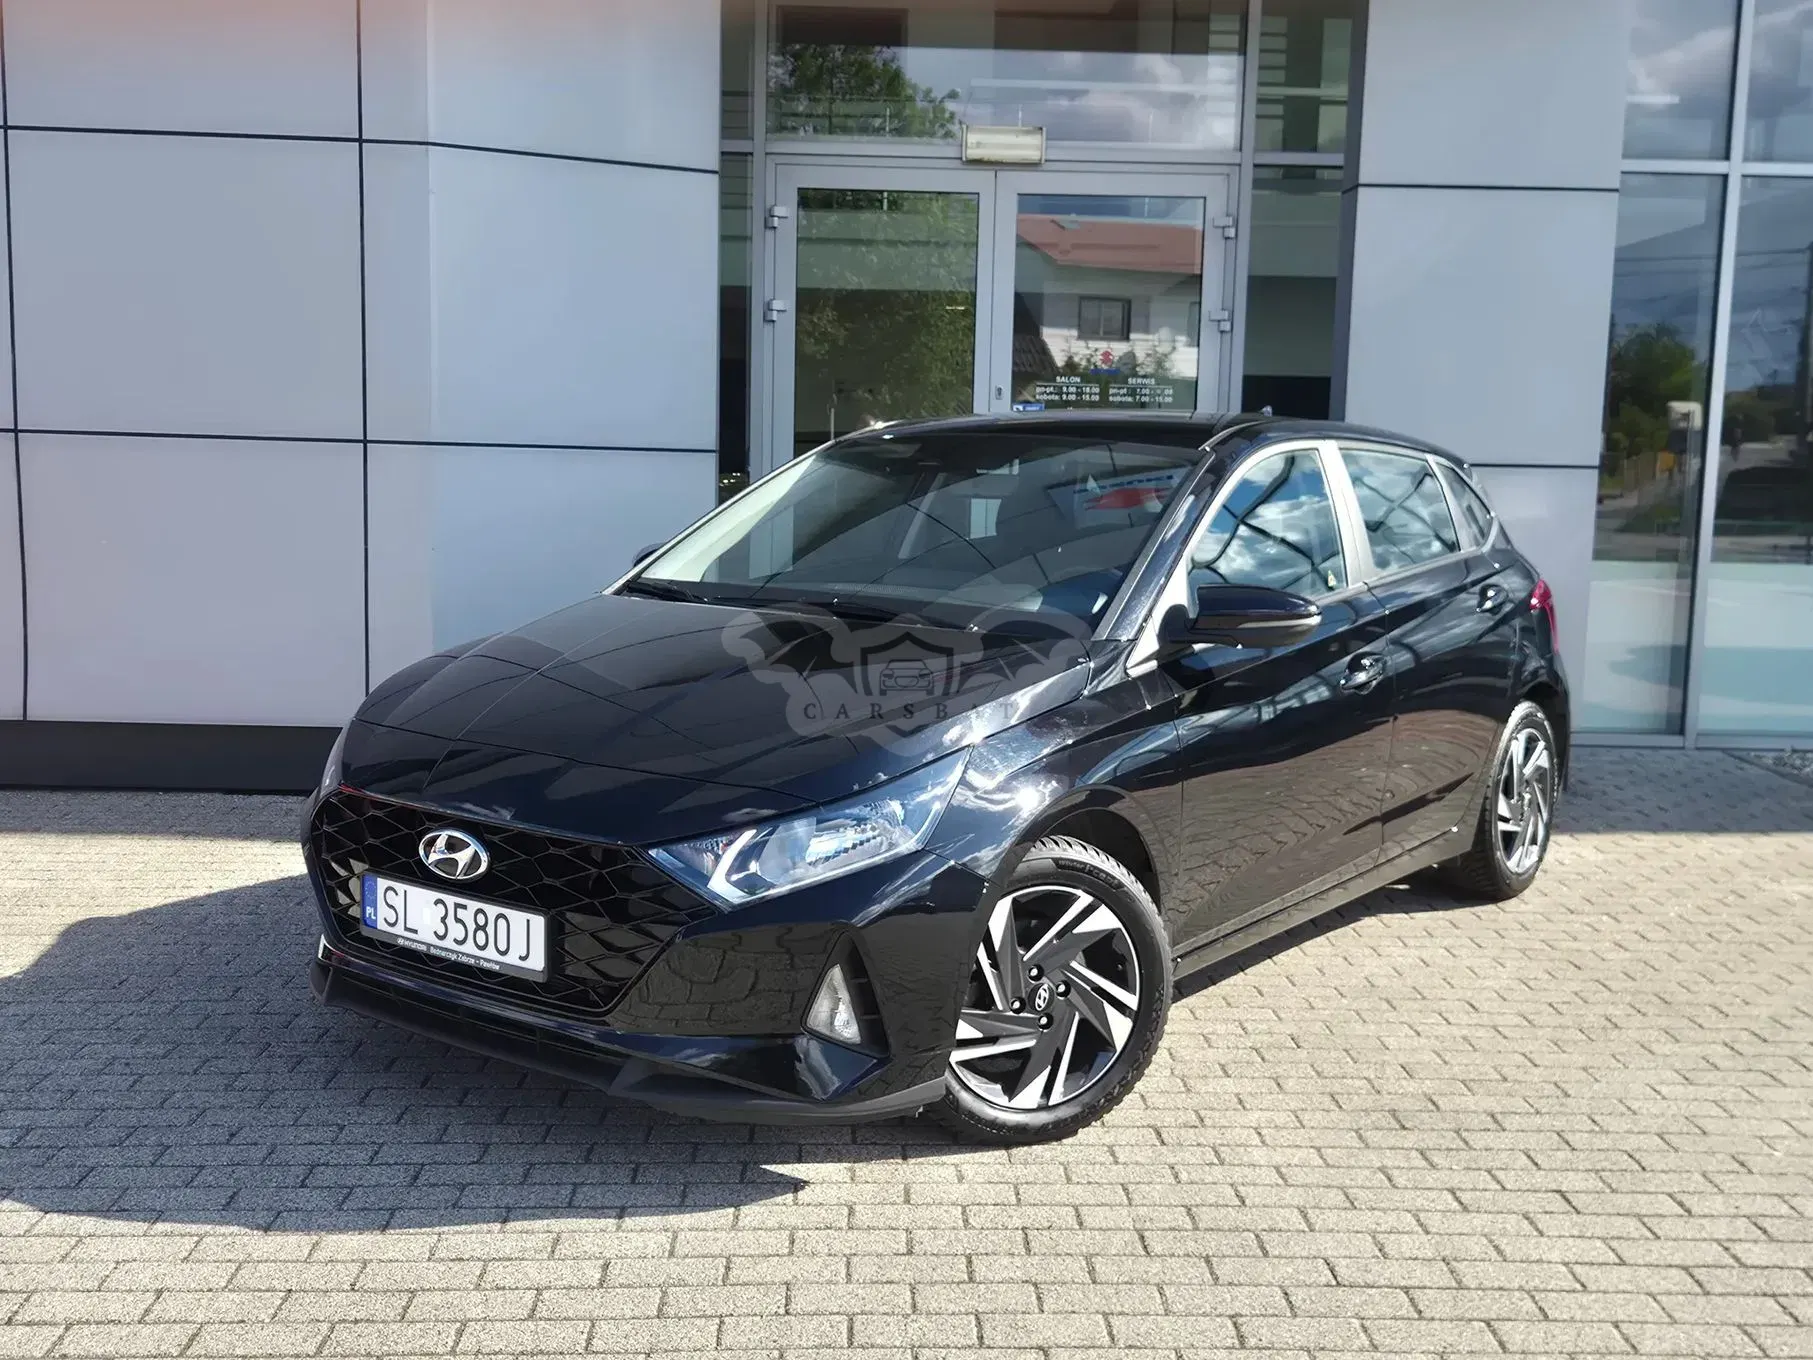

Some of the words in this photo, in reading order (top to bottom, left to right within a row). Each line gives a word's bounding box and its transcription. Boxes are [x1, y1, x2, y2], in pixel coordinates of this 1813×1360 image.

[1128, 377, 1155, 385] SERWIS
[366, 906, 376, 920] PL
[384, 886, 418, 934] SL
[433, 898, 531, 962] 3580J
